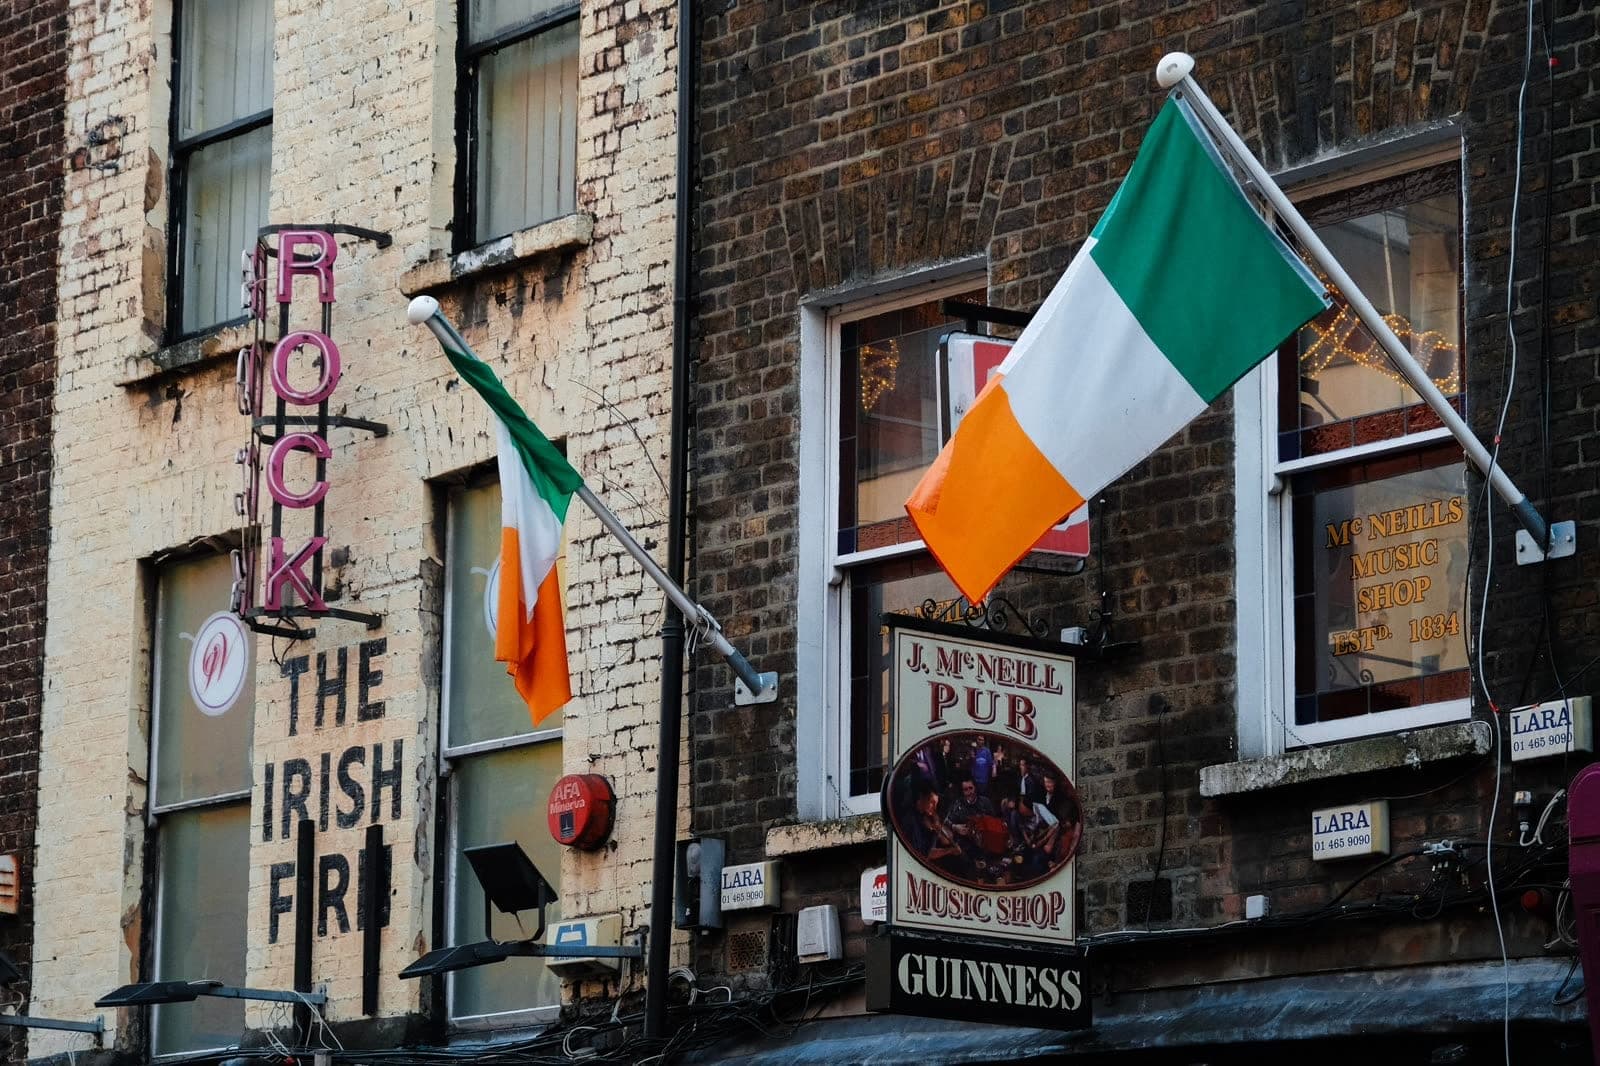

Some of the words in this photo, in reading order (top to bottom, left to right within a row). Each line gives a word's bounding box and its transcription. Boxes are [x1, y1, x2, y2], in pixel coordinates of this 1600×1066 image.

[264, 229, 341, 612] ROCK
[1367, 496, 1464, 540] NEILLS
[1351, 538, 1439, 580] MUSIC
[1358, 575, 1432, 613] SHOP
[1408, 610, 1460, 642] 1834
[906, 642, 930, 674] J.
[280, 636, 388, 737] THE
[927, 680, 1038, 741] PUB
[1512, 707, 1573, 736] LARA
[1513, 741, 1525, 753] 01
[1528, 736, 1546, 749] 465
[1548, 731, 1573, 746] 9090
[263, 738, 404, 842] IRISH
[554, 782, 581, 802] AFA
[549, 798, 586, 815] Minerva
[1313, 809, 1370, 835] LARA
[1314, 841, 1325, 852] 01
[1328, 838, 1345, 850] 465
[1347, 834, 1370, 847] 9090
[722, 868, 764, 890] LARA
[722, 895, 730, 904] 01
[733, 892, 745, 903] 465
[746, 890, 764, 901] 9090
[905, 870, 992, 923] MUSIC
[997, 890, 1066, 931] SHOP
[897, 952, 1082, 1012] GUINNESS
